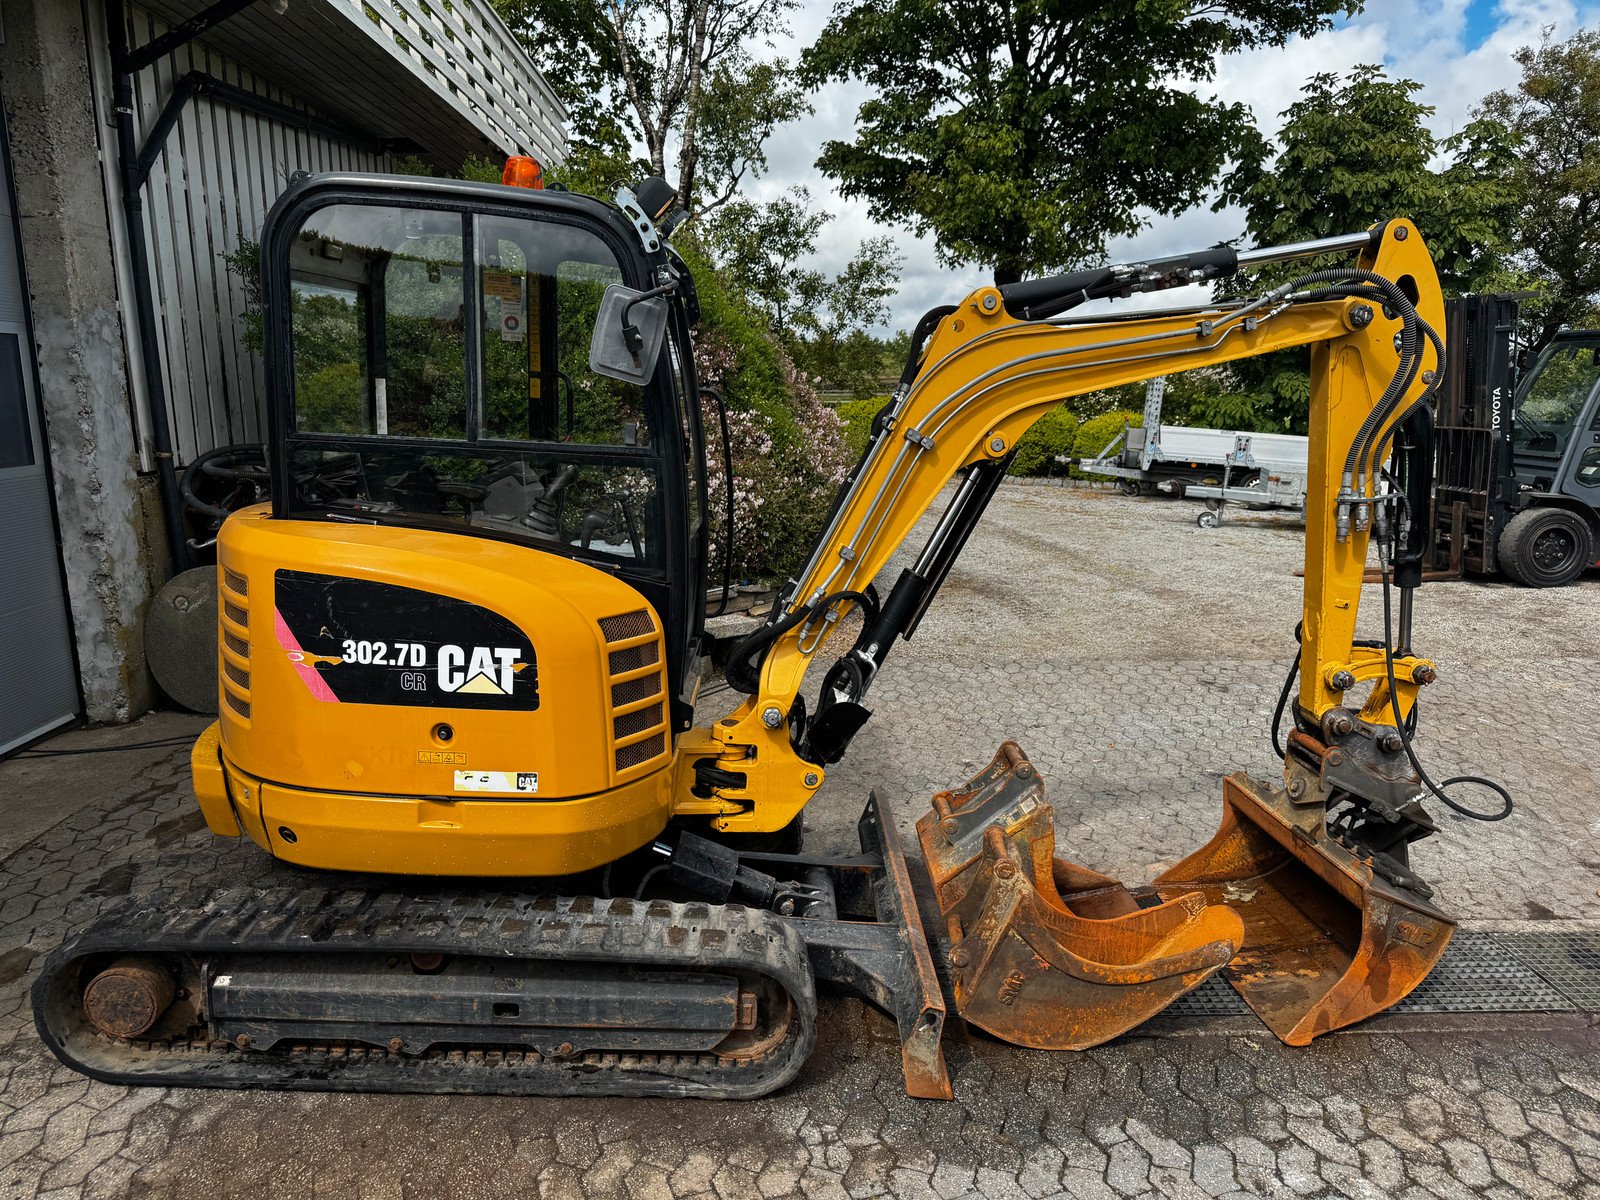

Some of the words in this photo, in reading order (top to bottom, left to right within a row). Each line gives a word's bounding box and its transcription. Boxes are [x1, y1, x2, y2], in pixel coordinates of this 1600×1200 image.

[1492, 386, 1502, 430] TOYOTA
[342, 640, 427, 667] 302.7D
[401, 672, 427, 691] CR
[437, 644, 522, 695] CAT
[518, 776, 537, 788] CAT
